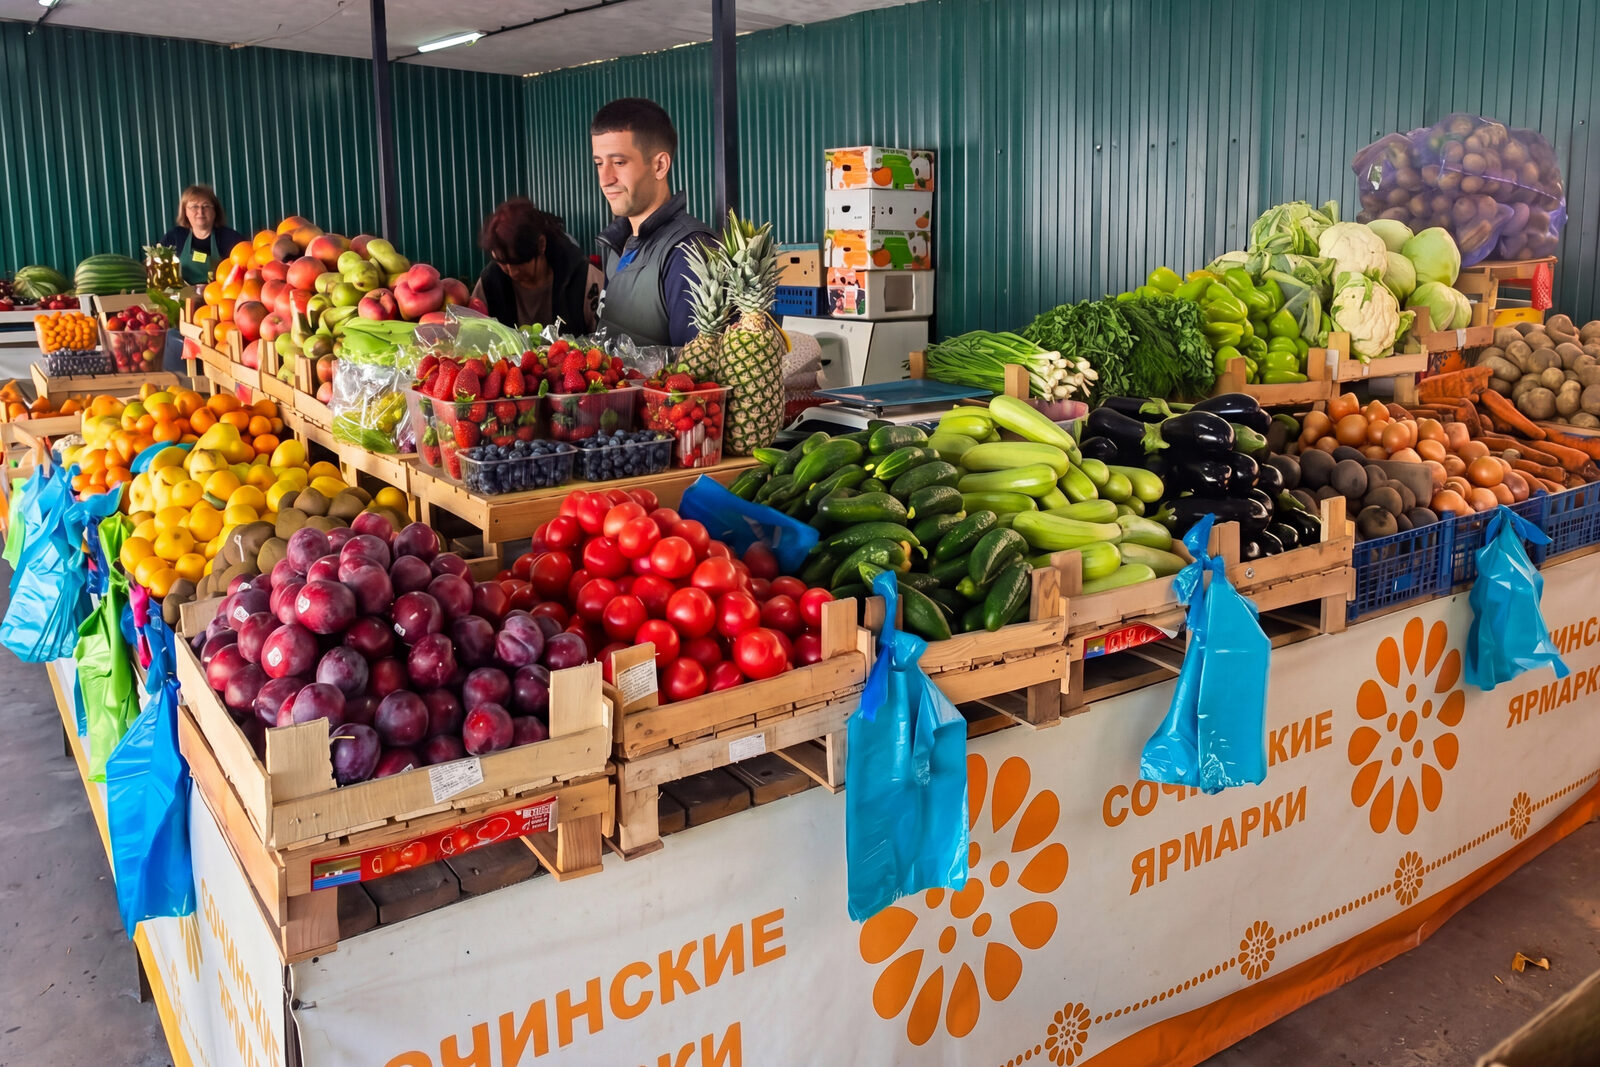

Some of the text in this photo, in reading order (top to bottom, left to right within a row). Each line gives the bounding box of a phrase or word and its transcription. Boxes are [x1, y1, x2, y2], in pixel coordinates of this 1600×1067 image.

[1506, 664, 1600, 728] ЯРМАРК
[1129, 785, 1307, 896] ЯРМАРКИ
[384, 907, 787, 1067] ЧИНСКИЕ
